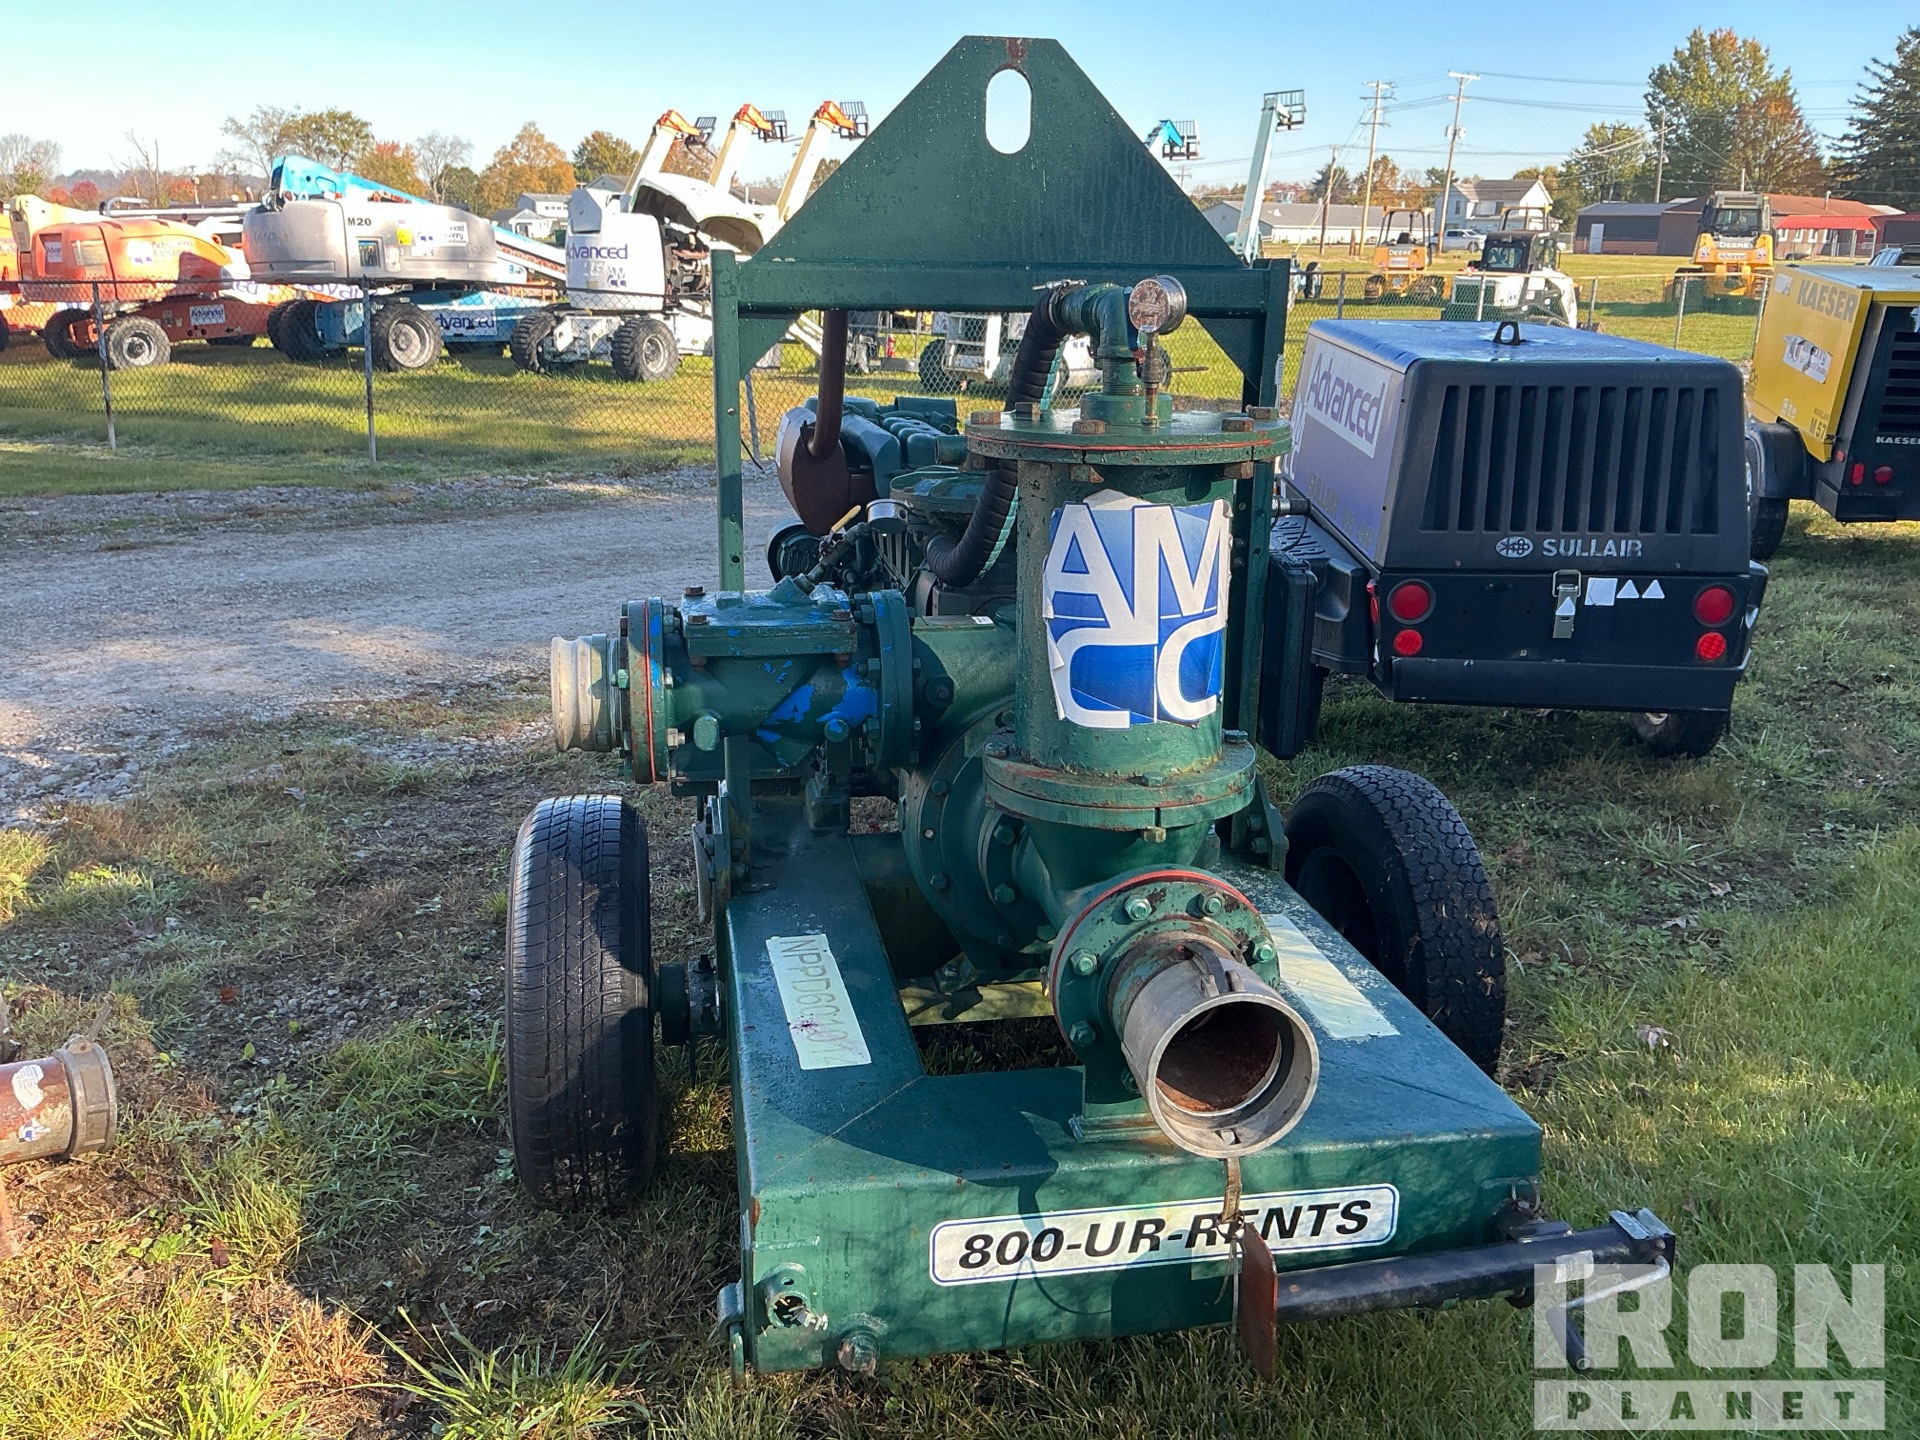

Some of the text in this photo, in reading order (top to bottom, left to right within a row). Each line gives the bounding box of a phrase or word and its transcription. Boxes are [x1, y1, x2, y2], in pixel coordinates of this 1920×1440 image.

[347, 217, 372, 226] M20
[1797, 279, 1859, 324] KAESER
[435, 313, 495, 330] dvanced
[1305, 352, 1386, 446] Advanced
[1542, 538, 1643, 558] SULLAIR
